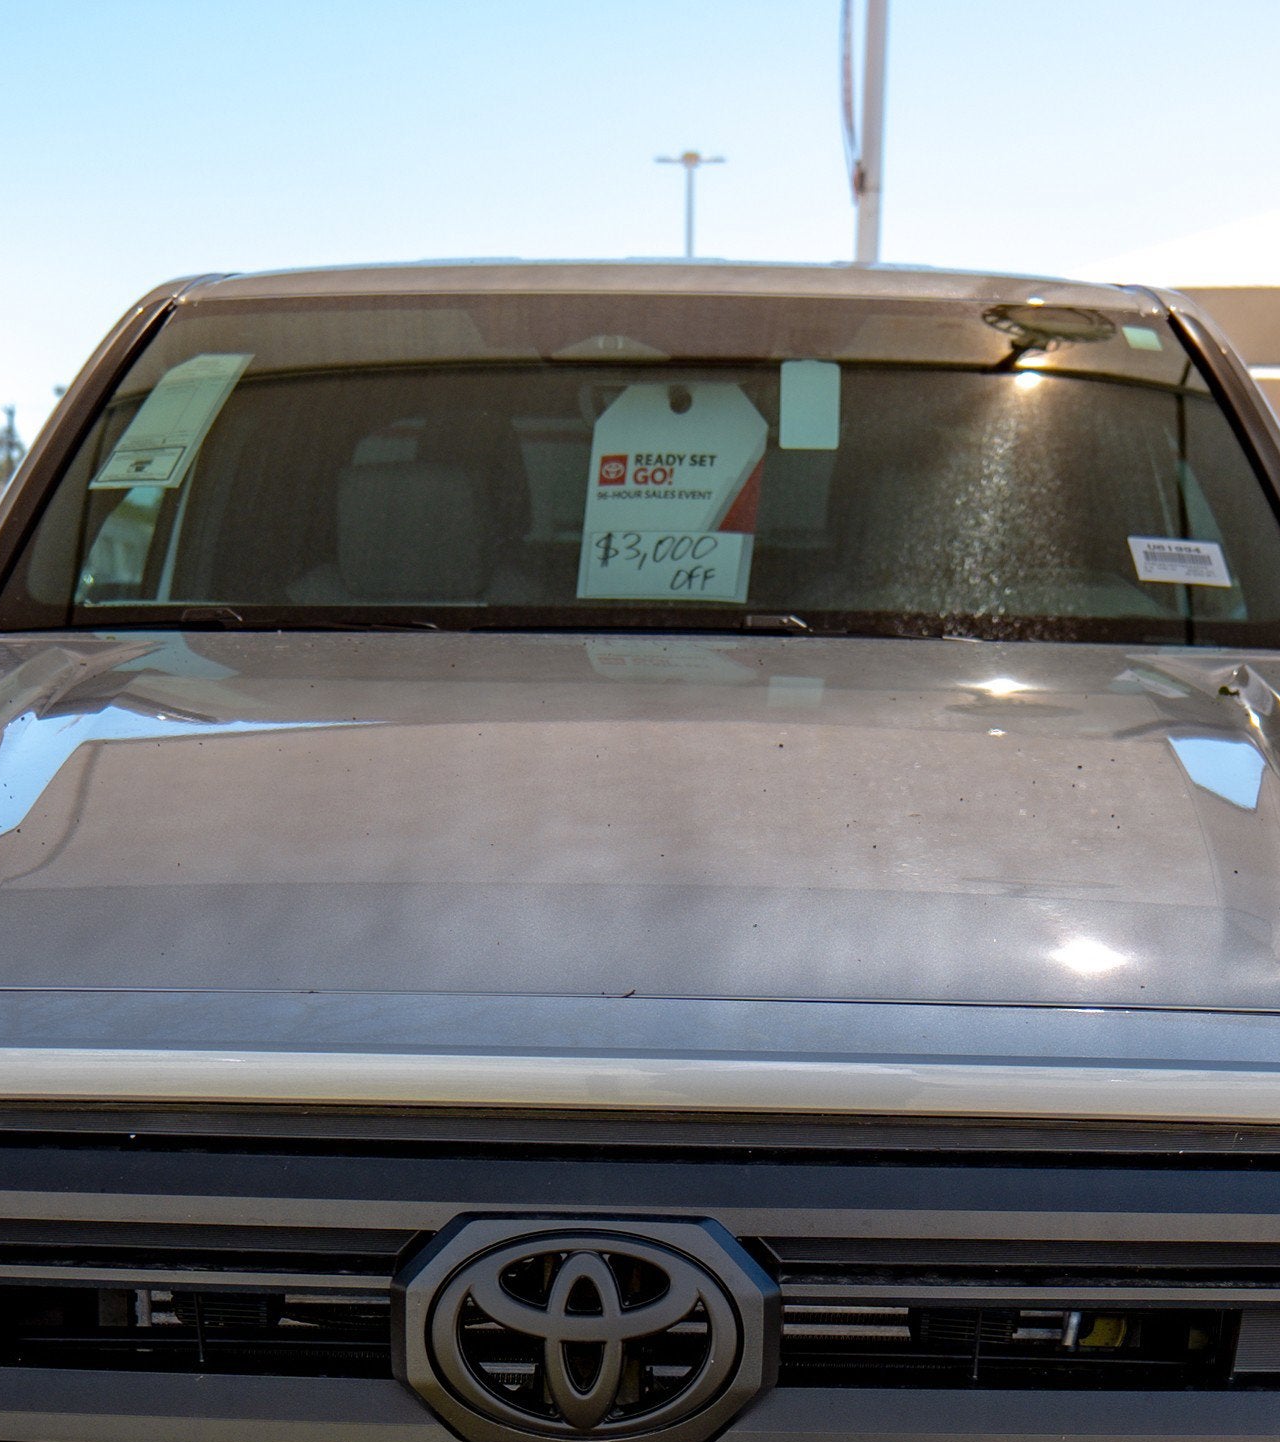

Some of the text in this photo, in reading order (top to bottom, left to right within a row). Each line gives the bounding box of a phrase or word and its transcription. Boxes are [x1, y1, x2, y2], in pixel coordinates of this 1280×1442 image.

[634, 454, 717, 467] READY SET
[632, 467, 674, 486] GO!
[644, 489, 676, 500] SALES
[678, 490, 713, 501] EVENT
[595, 532, 718, 570] $3,000
[670, 565, 716, 591] OFF
